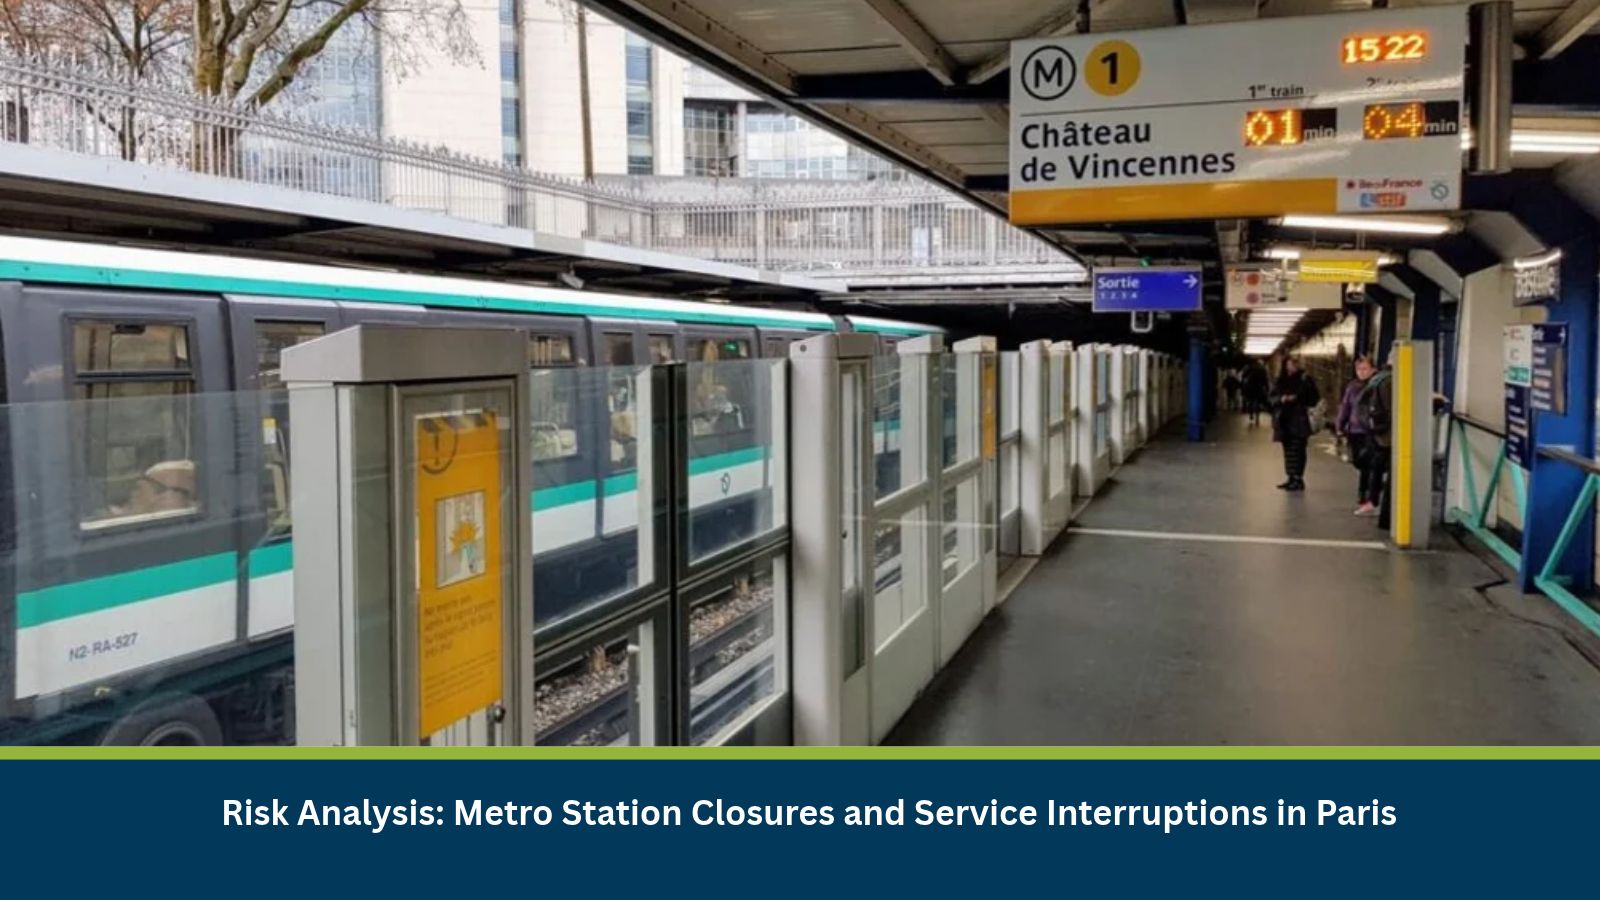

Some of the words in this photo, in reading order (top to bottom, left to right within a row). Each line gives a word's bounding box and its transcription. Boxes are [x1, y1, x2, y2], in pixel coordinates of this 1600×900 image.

[1034, 57, 1063, 89] M
[1101, 52, 1119, 84] 1
[1271, 84, 1304, 97] train
[1021, 120, 1151, 149] Château
[1246, 109, 1297, 146] 01
[1304, 126, 1336, 141] min
[1365, 103, 1423, 140] 04
[1425, 119, 1457, 134] min
[1021, 156, 1057, 182] de
[1068, 152, 1236, 180] Vincennes
[1098, 275, 1140, 290] Sortie
